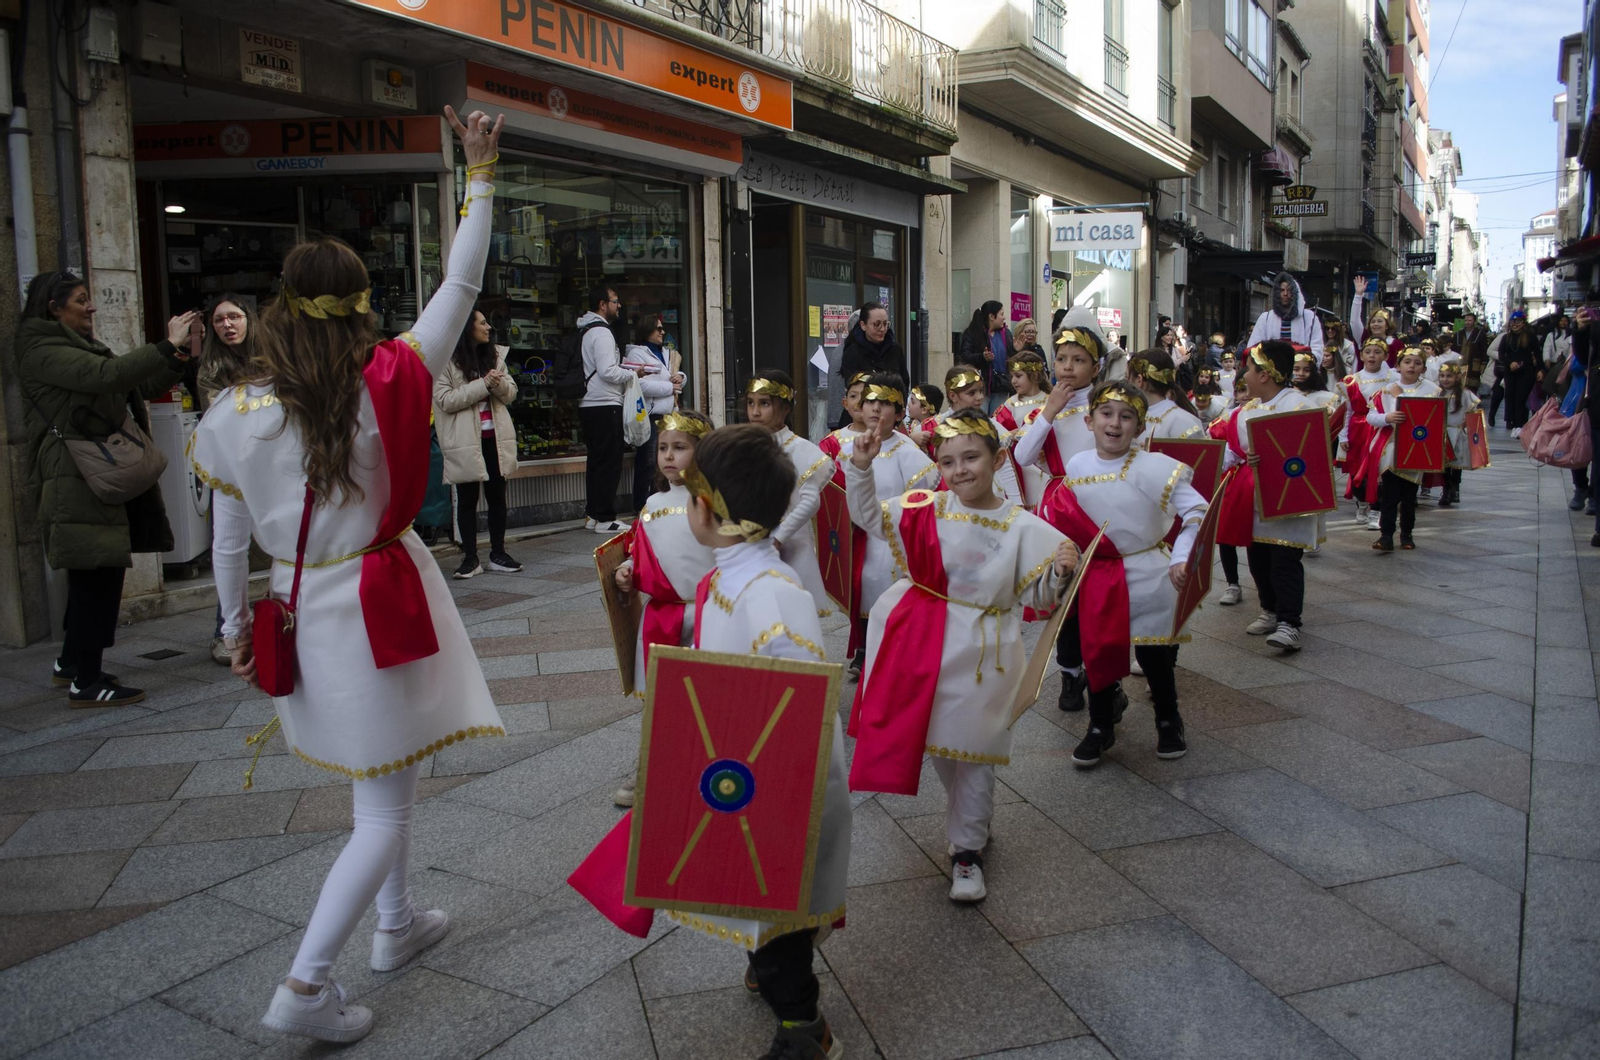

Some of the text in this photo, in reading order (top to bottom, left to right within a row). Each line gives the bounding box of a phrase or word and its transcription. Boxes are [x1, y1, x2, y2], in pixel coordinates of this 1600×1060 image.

[243, 30, 296, 52] VENDE:
[501, 0, 625, 71] PENIN
[256, 53, 291, 71] M.I.D.
[670, 60, 735, 94] expert
[484, 81, 544, 105] expert
[136, 119, 404, 154] expert PENIN
[256, 158, 326, 172] GAMEBOY
[742, 157, 856, 203] Le Petit Détail
[1287, 187, 1314, 199] REY
[929, 203, 939, 219] 24
[1273, 204, 1325, 216] PELUQUERIA
[1055, 220, 1136, 243] mi casa
[1408, 255, 1435, 265] ROSLY
